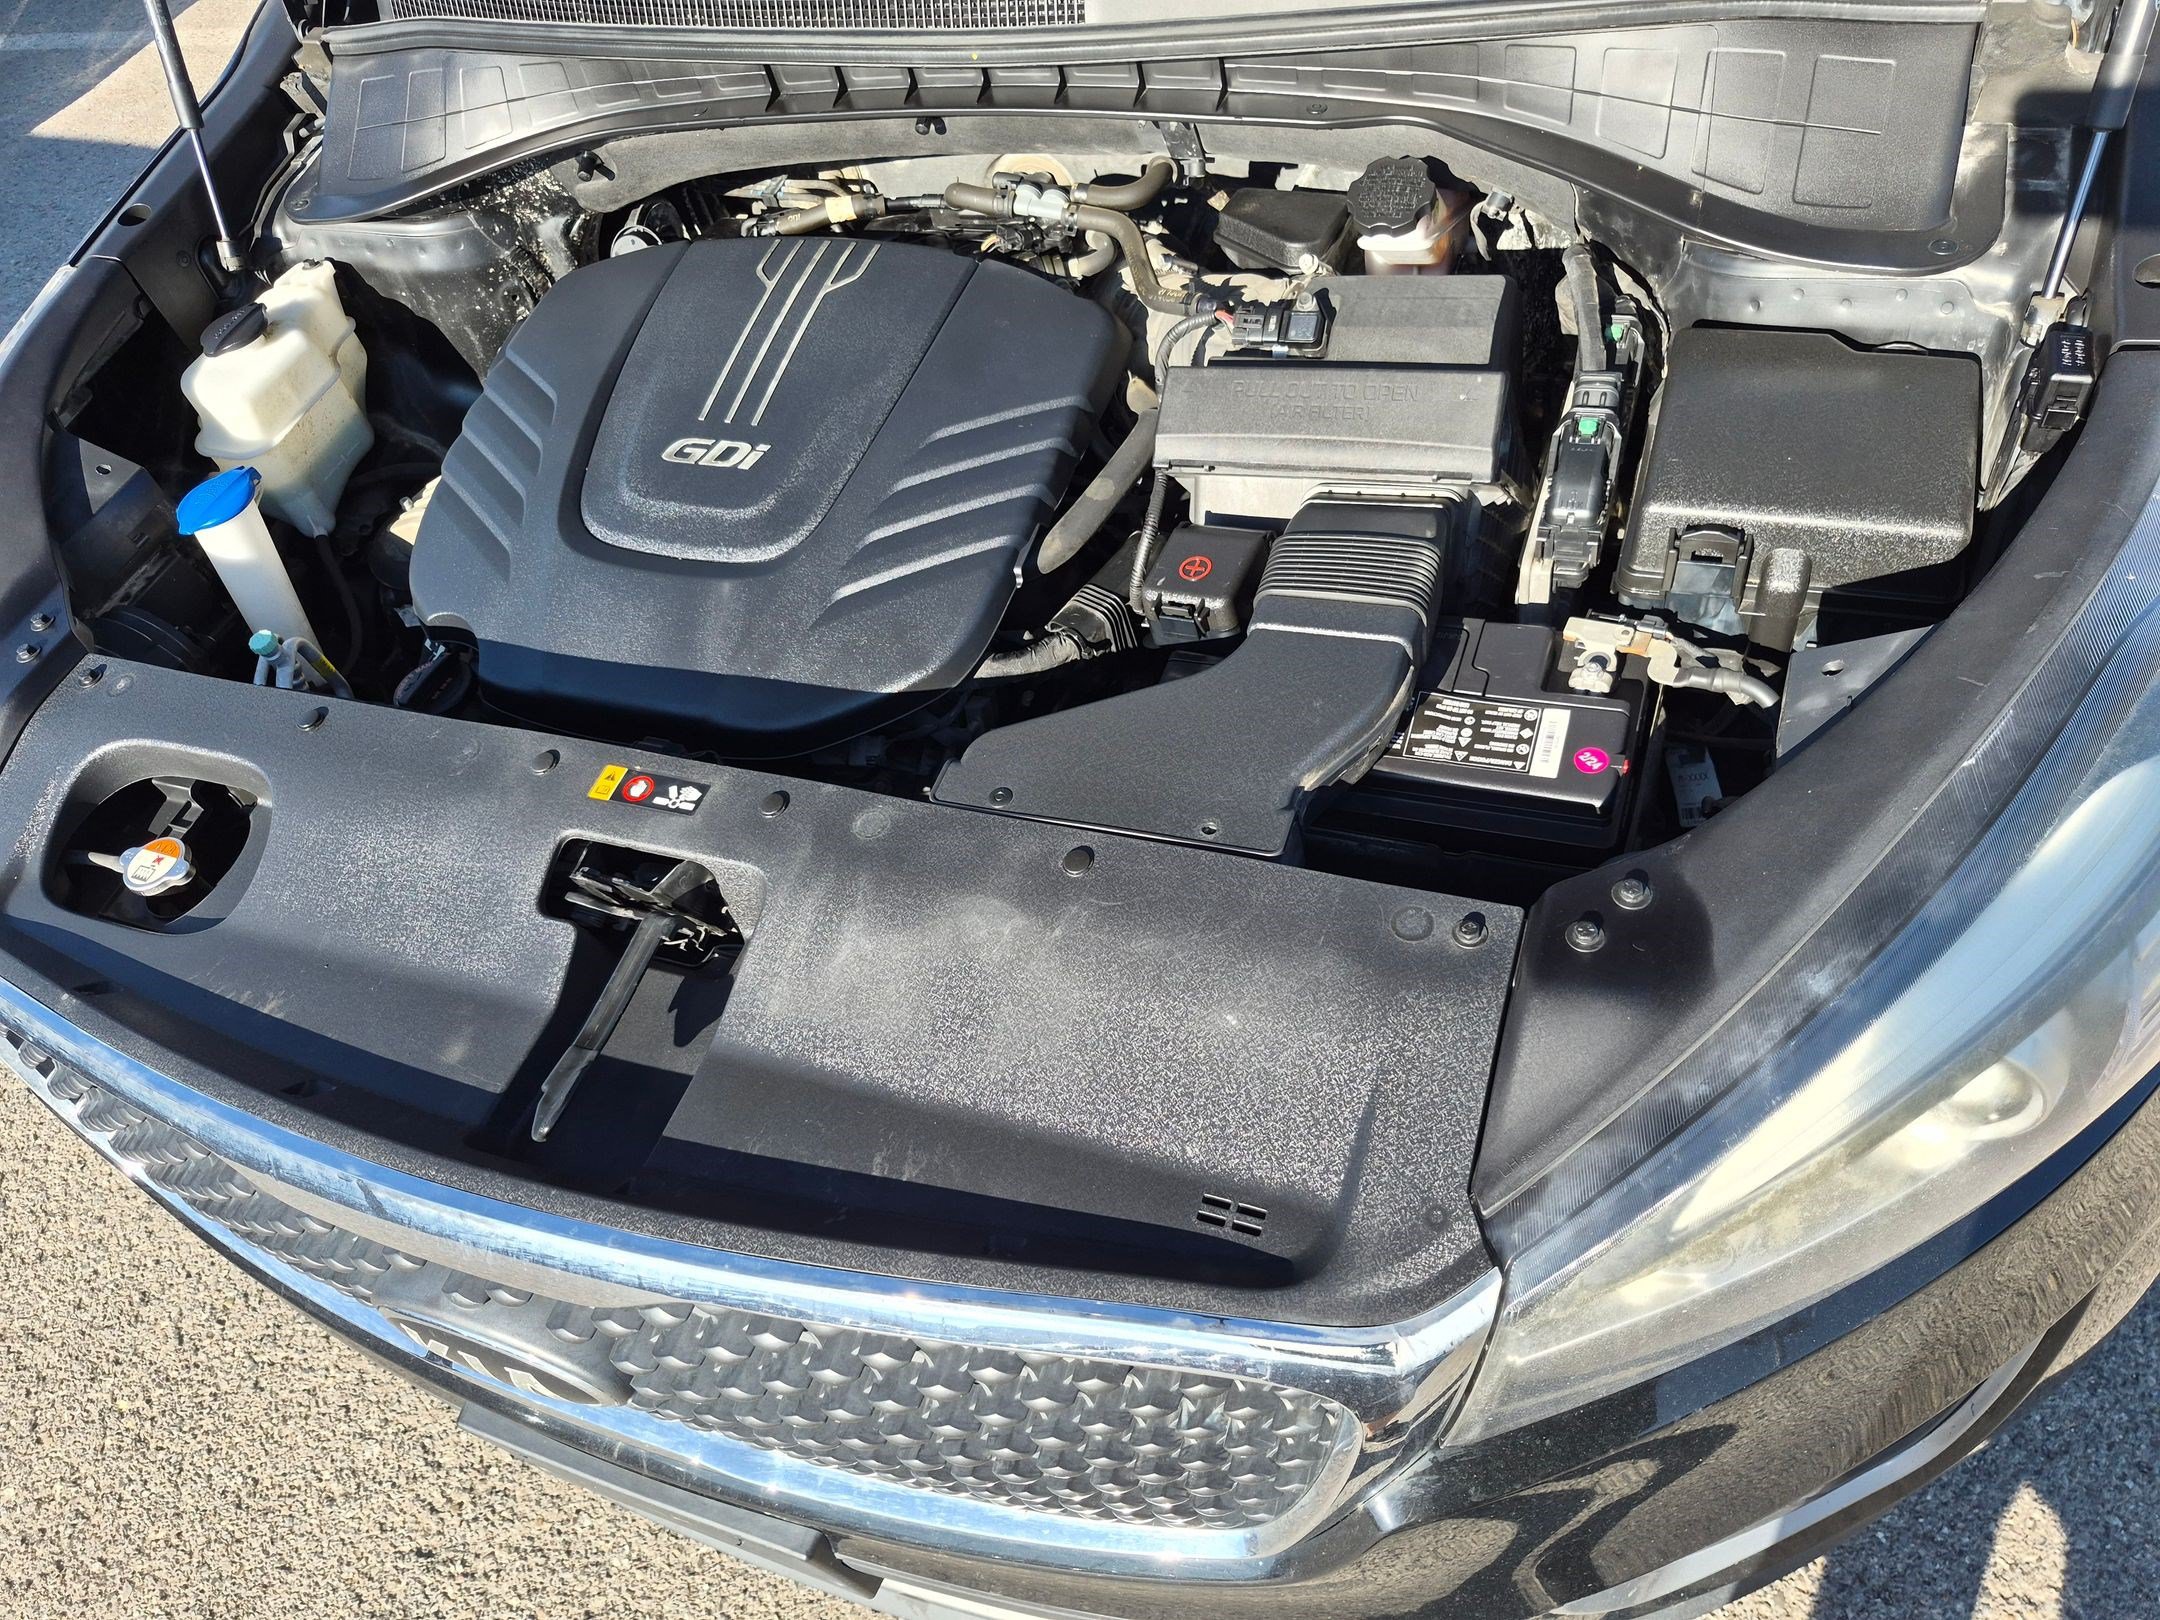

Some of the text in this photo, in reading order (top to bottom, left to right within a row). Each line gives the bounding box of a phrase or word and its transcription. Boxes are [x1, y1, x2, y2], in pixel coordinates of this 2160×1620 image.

[1232, 379, 1418, 401] PULL OUT TO OPEN
[661, 438, 771, 470] GDi
